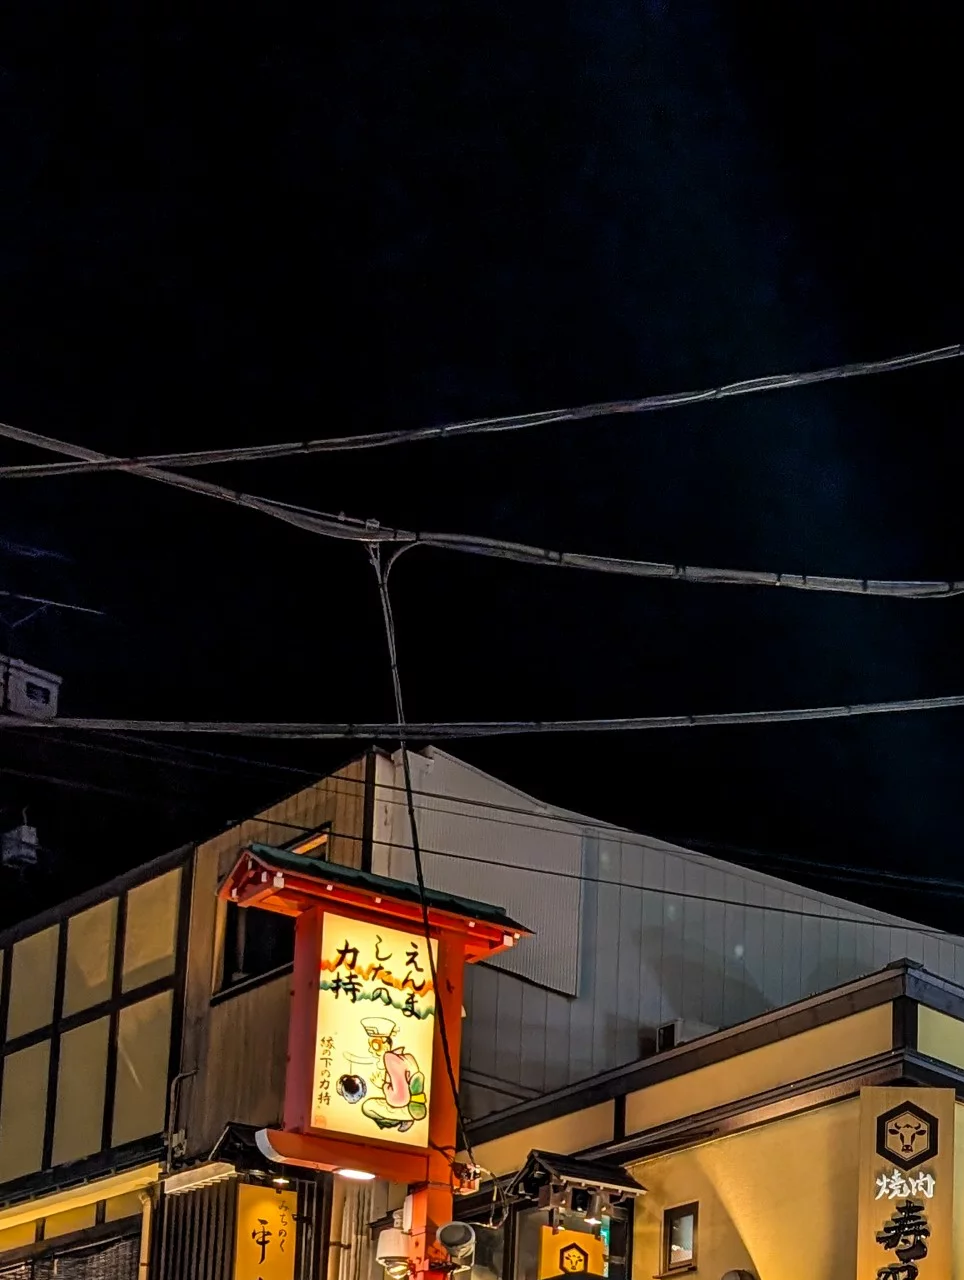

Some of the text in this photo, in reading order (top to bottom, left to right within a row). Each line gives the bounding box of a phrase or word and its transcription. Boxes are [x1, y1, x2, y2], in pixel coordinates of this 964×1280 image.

[330, 939, 363, 1003] 力持
[371, 934, 393, 1006] したの
[402, 941, 426, 1020] えんま
[875, 1168, 935, 1200] 焼肉
[278, 1200, 290, 1252] みちのく
